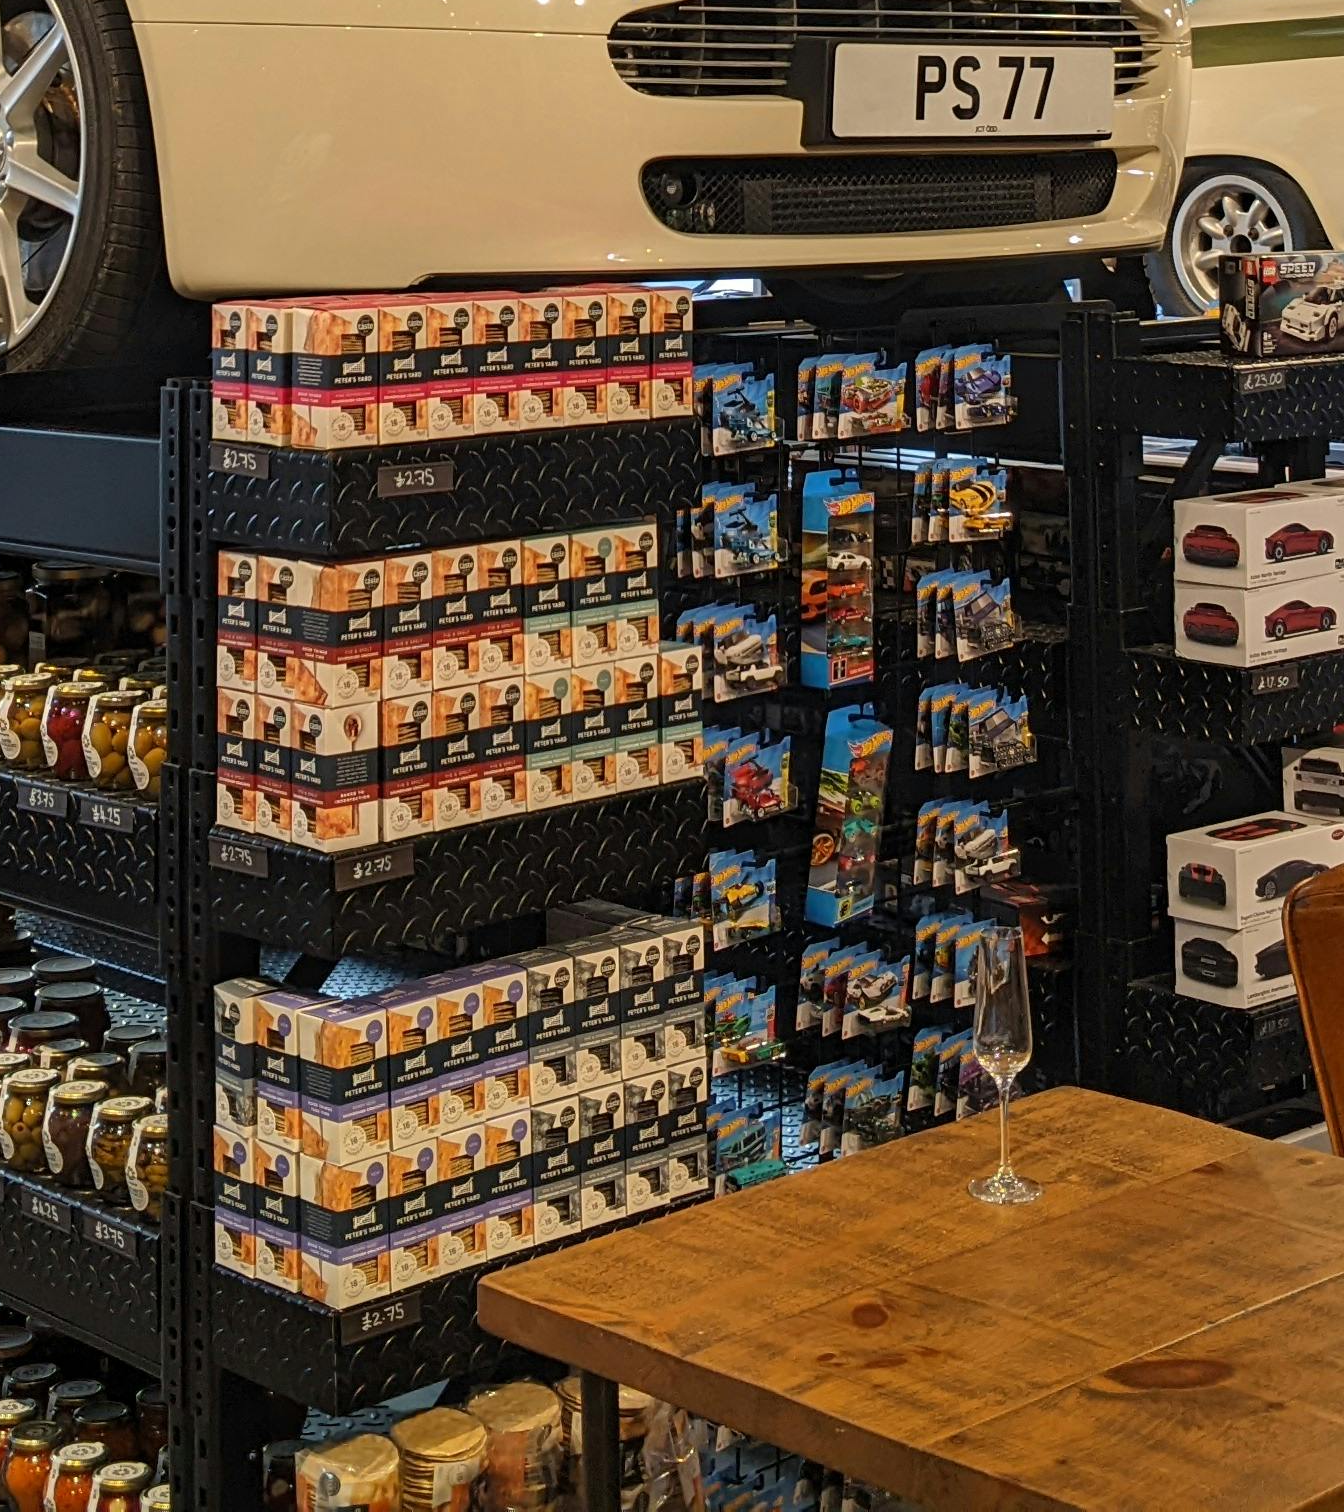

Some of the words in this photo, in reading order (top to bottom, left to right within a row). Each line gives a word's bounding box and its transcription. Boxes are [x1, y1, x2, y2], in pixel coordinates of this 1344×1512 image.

[915, 55, 981, 121] PS
[998, 56, 1056, 121] 77
[1279, 261, 1316, 274] SPEED
[1245, 372, 1283, 389] £23.00
[394, 469, 434, 488] £2.75
[1259, 676, 1289, 689] £17.50
[221, 846, 252, 866] £2.75
[353, 856, 391, 878] £2.75
[362, 1303, 405, 1331] £2.75
